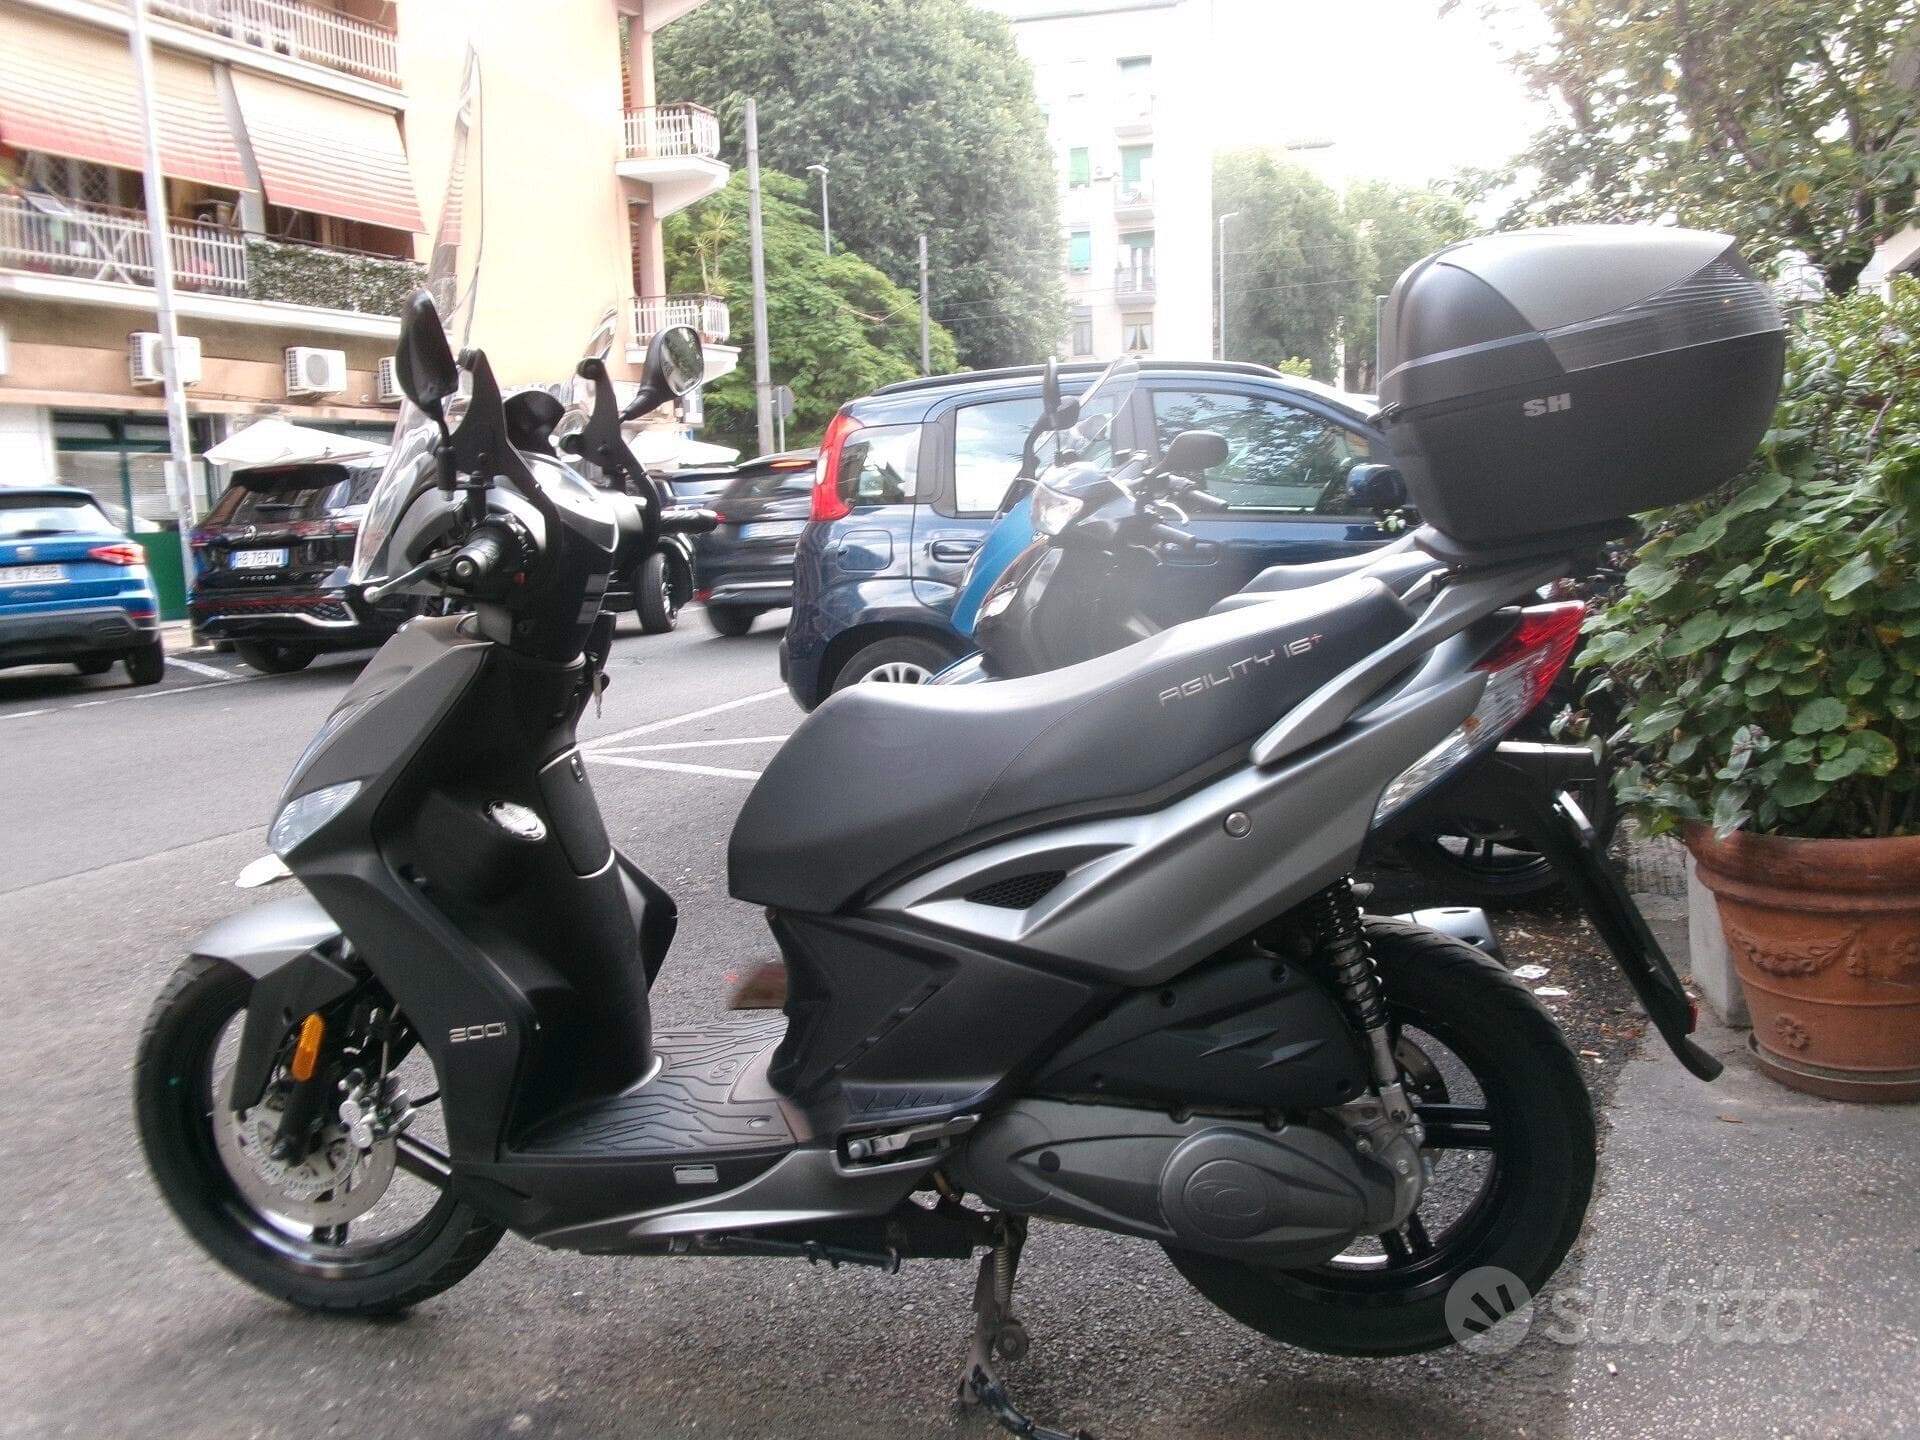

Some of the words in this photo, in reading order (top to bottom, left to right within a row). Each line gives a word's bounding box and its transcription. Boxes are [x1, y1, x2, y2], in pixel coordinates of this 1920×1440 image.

[1523, 392, 1571, 417] SH
[1158, 649, 1275, 706] AGILITY
[448, 1022, 508, 1043] 200i
